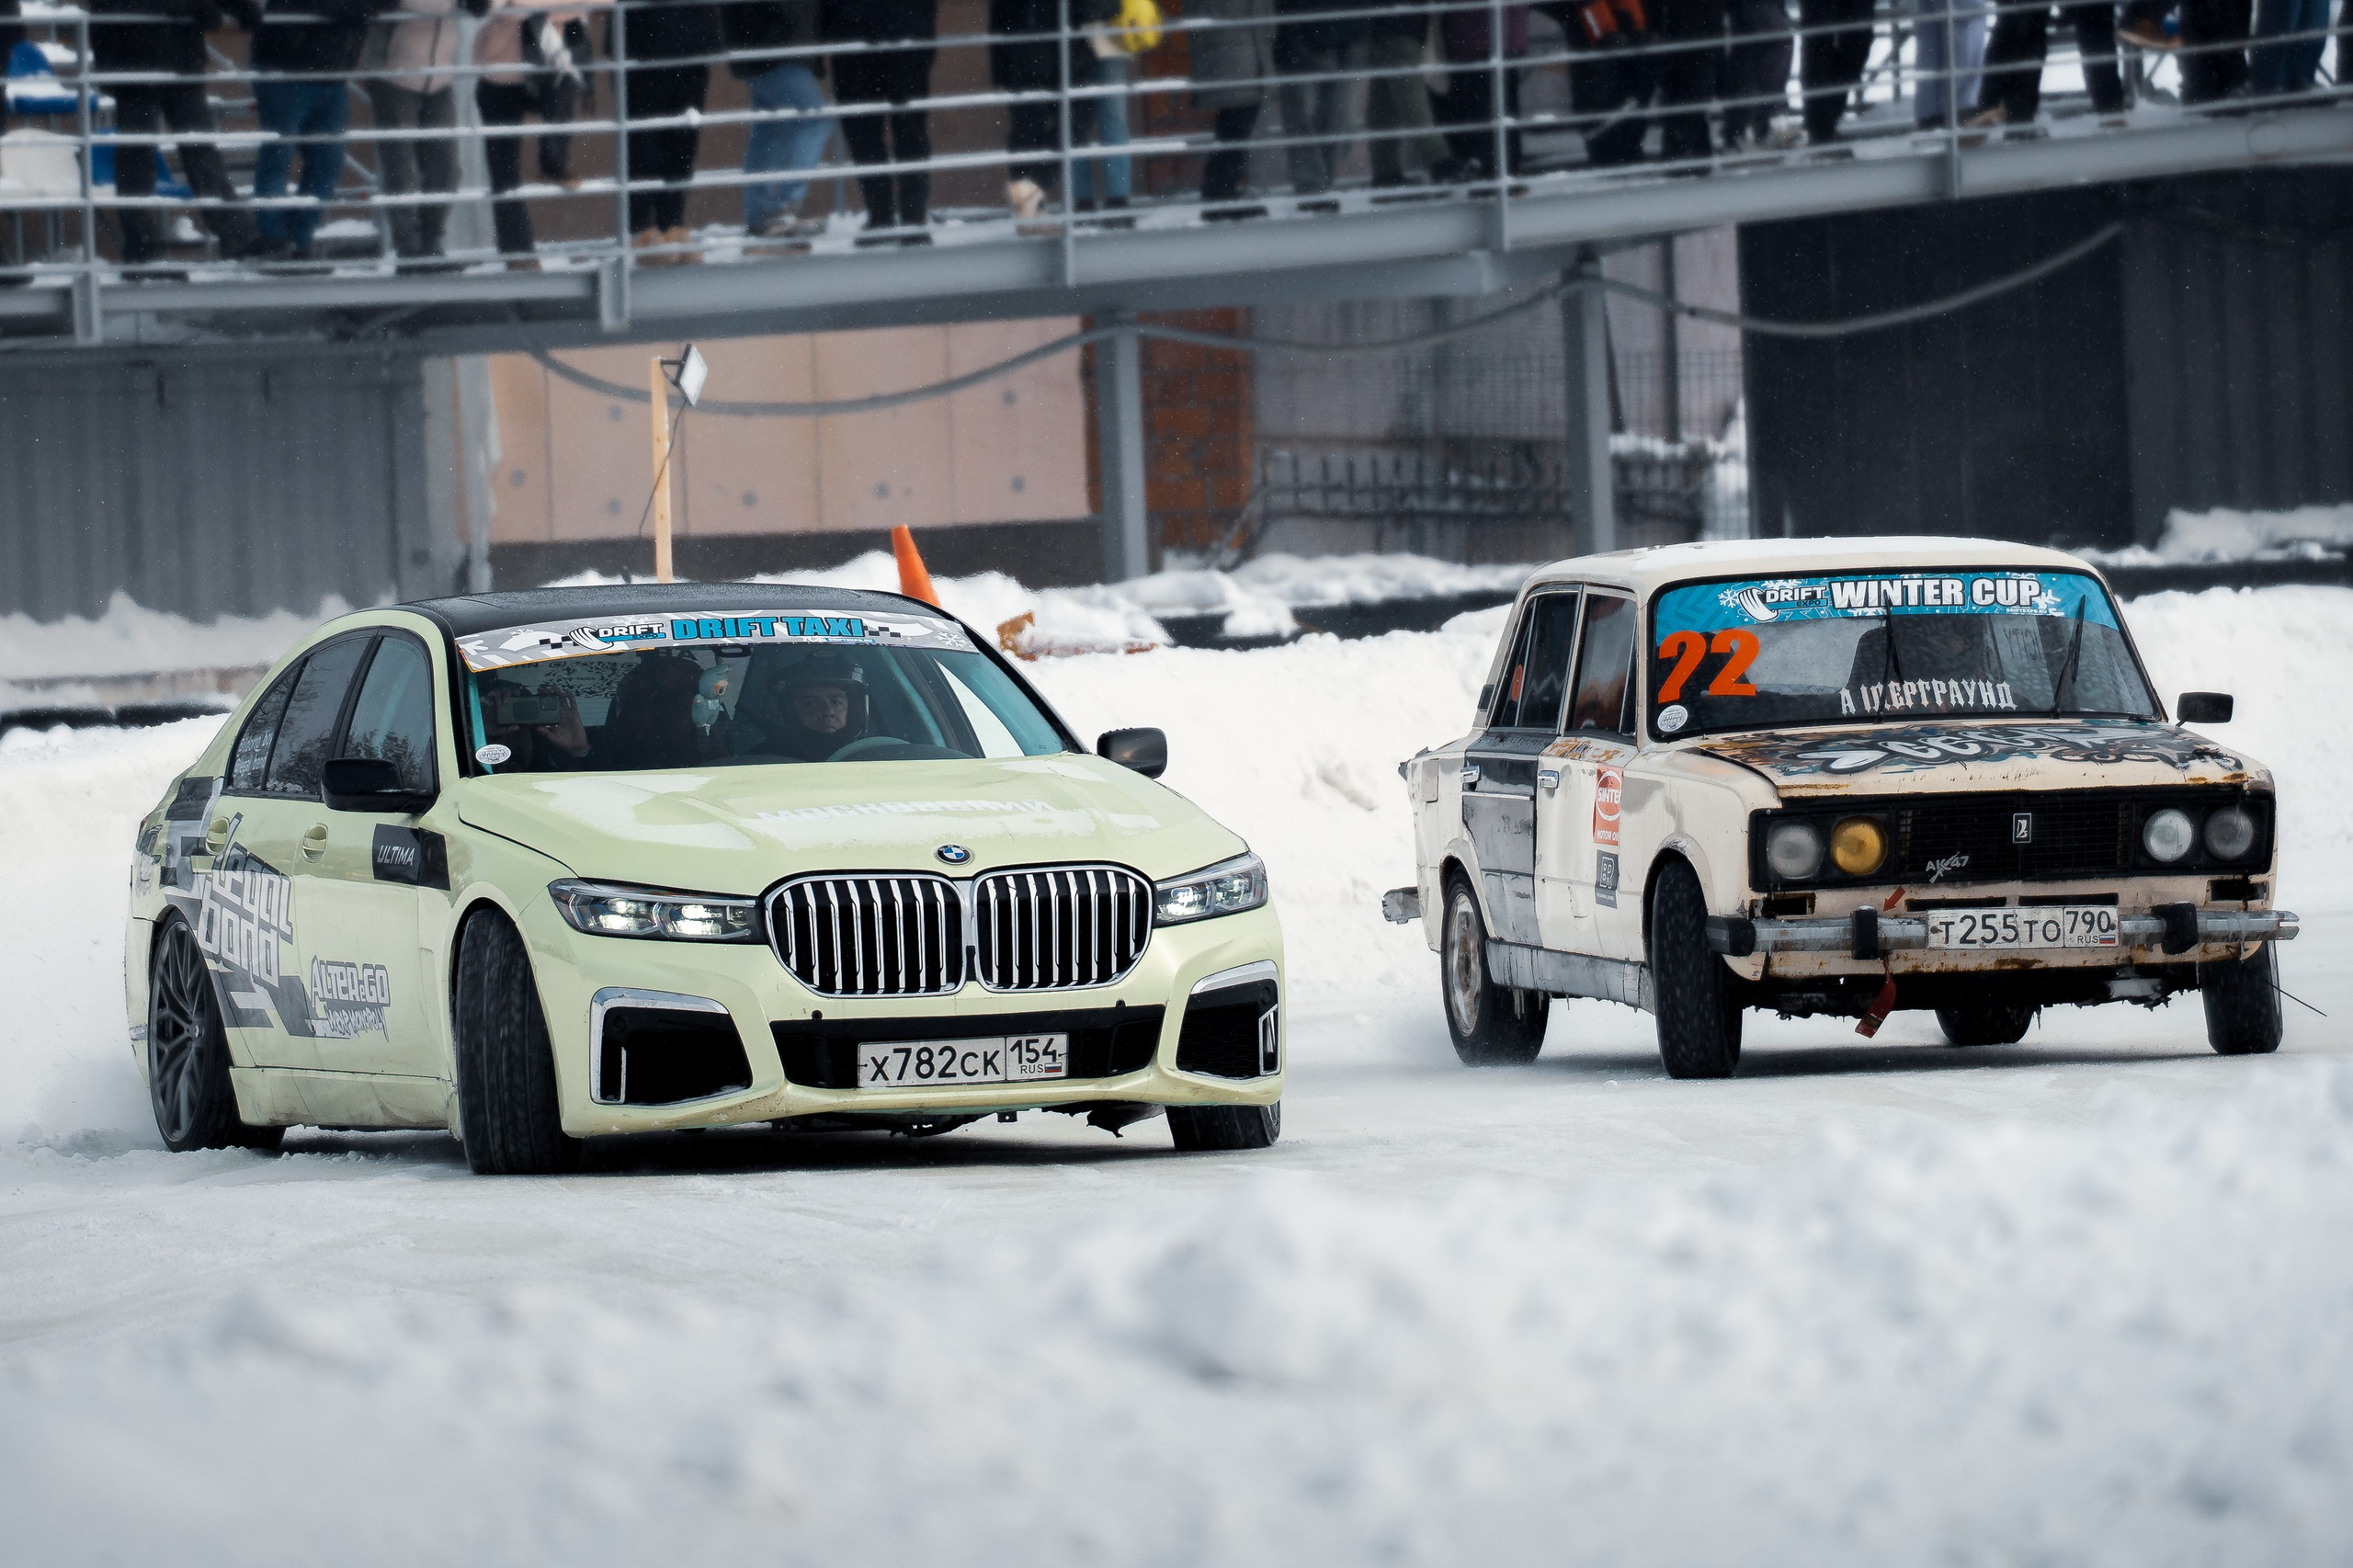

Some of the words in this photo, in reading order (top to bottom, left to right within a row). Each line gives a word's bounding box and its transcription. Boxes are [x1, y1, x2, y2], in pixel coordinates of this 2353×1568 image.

[1766, 585, 1827, 603] DRIFT
[1829, 578, 1966, 608] WINTER
[1971, 576, 2042, 608] CUP
[1796, 599, 1821, 608] EXPO
[599, 623, 664, 637] DRIFT
[671, 617, 779, 640] DRIFT
[780, 616, 865, 637] TAXI
[1658, 629, 1760, 704] 22
[1595, 828, 1612, 840] MOTOR
[377, 844, 415, 866] ULTIMA
[2065, 910, 2111, 934] 790
[2077, 935, 2099, 944] RUS
[1009, 1038, 1058, 1065] 154
[1020, 1063, 1043, 1074] RUS
